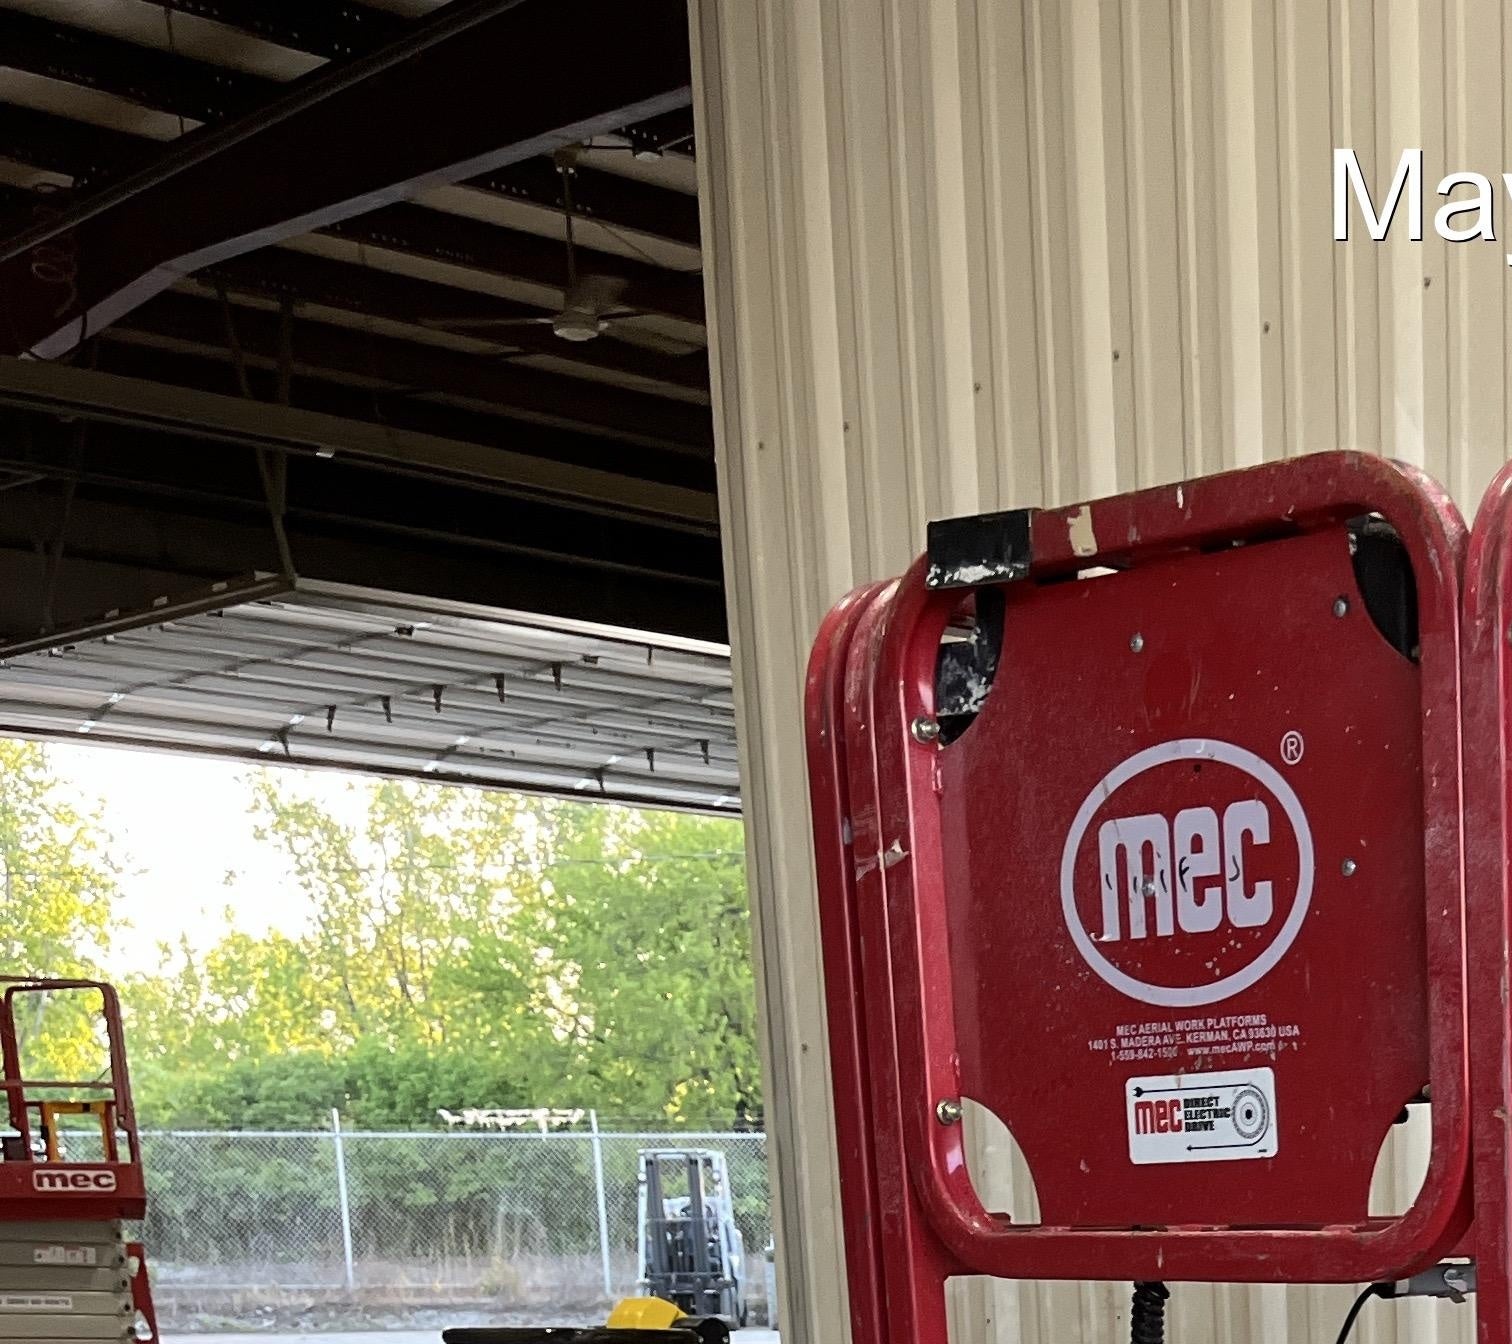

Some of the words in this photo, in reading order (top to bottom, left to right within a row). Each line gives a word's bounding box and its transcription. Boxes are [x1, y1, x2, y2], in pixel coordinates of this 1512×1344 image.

[1098, 799, 1274, 942] mec
[1116, 1024, 1137, 1036] MEC
[1138, 1021, 1173, 1035] AERIAL
[1175, 1018, 1205, 1032] WORK
[1206, 1014, 1267, 1029] PLATFORMS
[1278, 1025, 1300, 1037] USA
[1134, 1099, 1183, 1135] mec
[35, 1173, 116, 1188] mec
